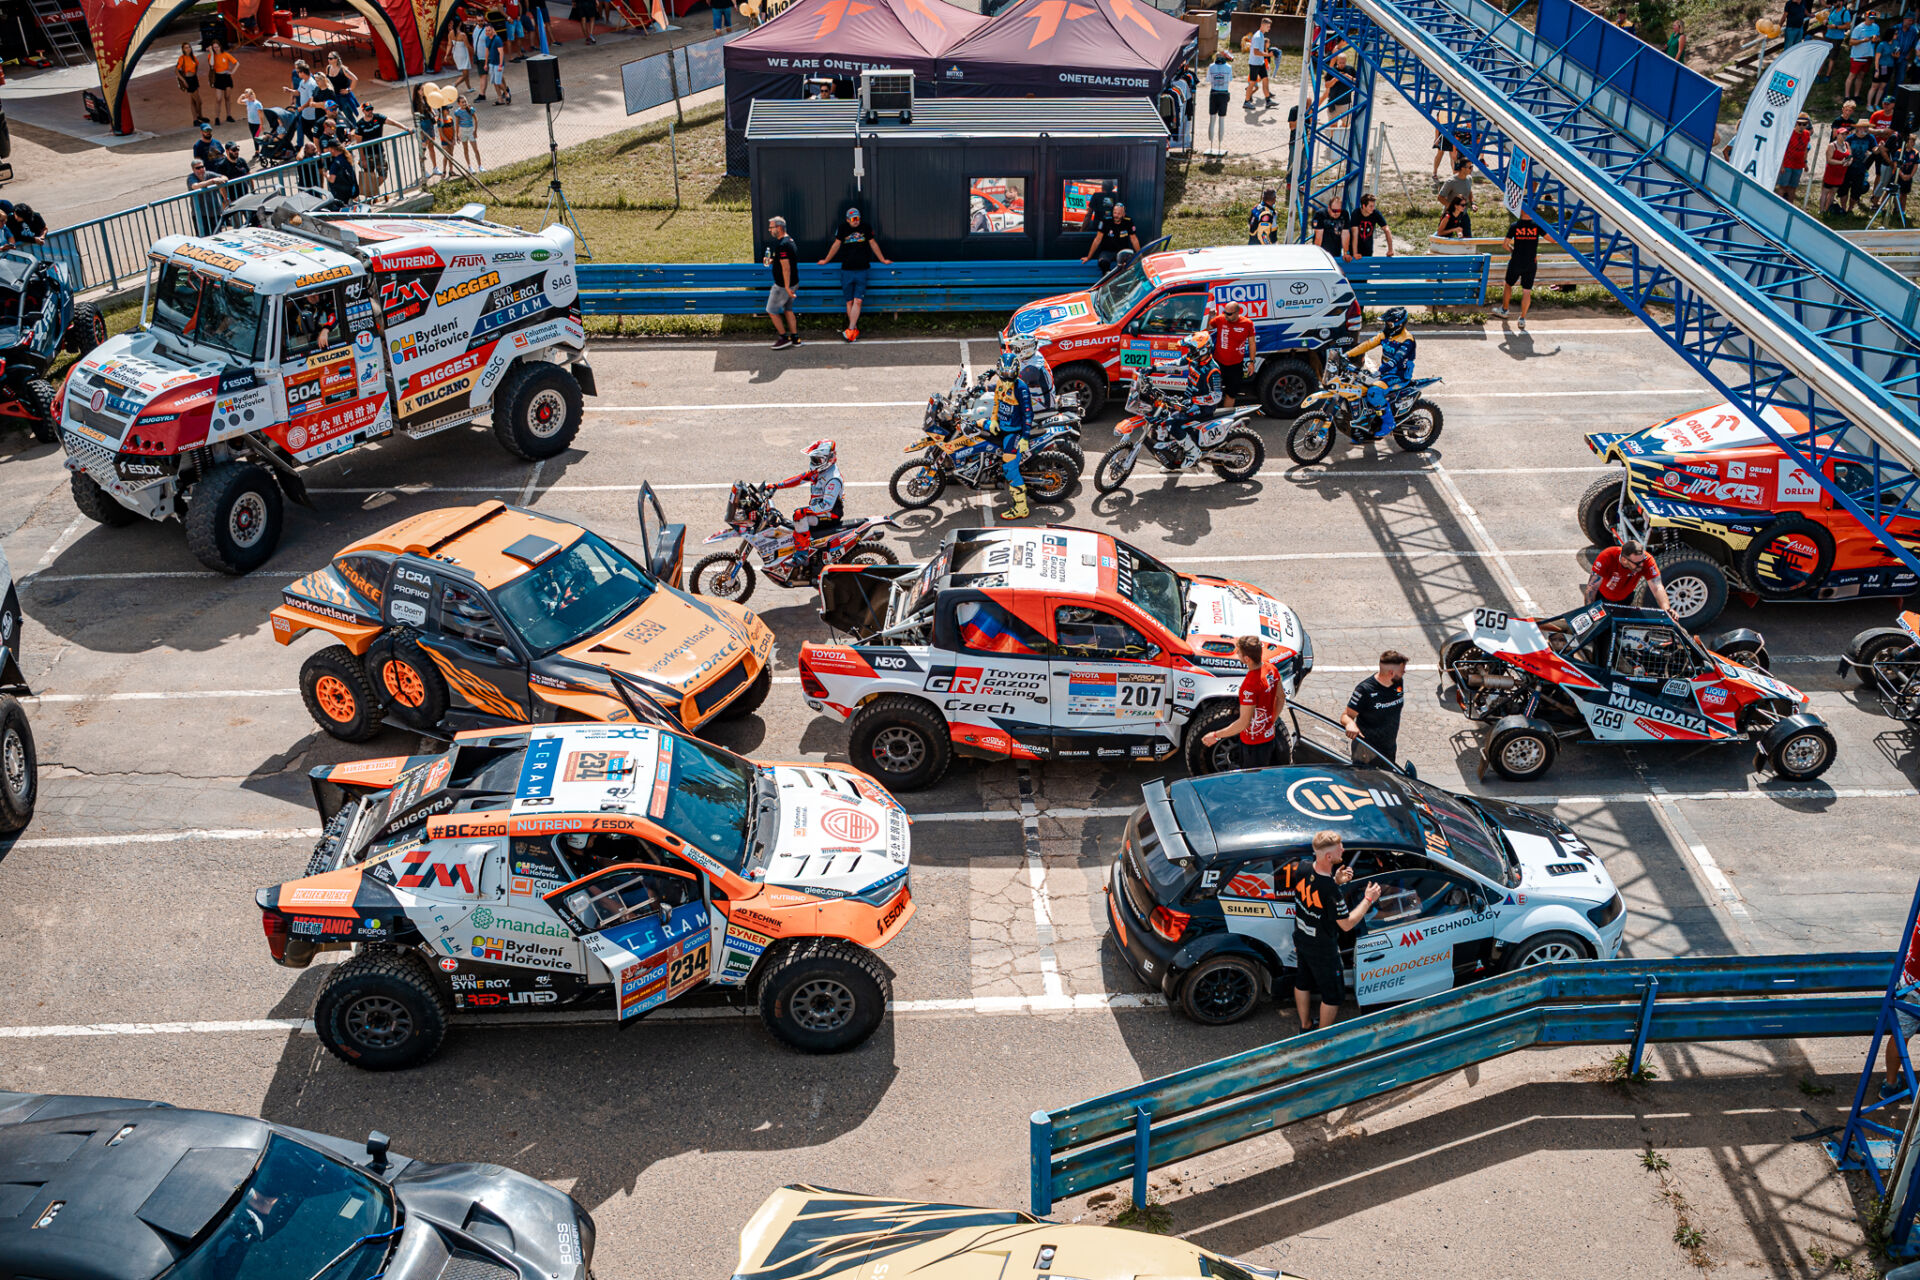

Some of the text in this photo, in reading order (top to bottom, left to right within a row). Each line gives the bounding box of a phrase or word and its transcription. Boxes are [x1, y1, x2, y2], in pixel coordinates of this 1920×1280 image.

[768, 58, 891, 71] WE ARE ONETEAM
[1059, 73, 1150, 88] ONETEAM.STORE
[382, 255, 436, 270] NUTREND
[449, 254, 487, 269] FRUM
[552, 275, 572, 290] SAG
[495, 283, 539, 309] SYNERGY
[1217, 285, 1265, 302] LIQUI
[1285, 298, 1324, 306] BSAUTO
[484, 297, 542, 330] LERAM
[416, 317, 458, 342] Bydlení
[357, 333, 371, 345] 77
[419, 330, 469, 357] Hořovice
[1074, 335, 1120, 347] BSAUTO
[1124, 353, 1147, 365] 2027
[420, 353, 479, 387] BIGGEST
[481, 355, 505, 388] CBSG
[228, 375, 253, 388] ESOX
[174, 390, 213, 406] BIGGEST
[288, 381, 321, 404] 604
[416, 377, 470, 408] VALCANO
[108, 397, 139, 414] LERAM
[141, 415, 175, 424] BUGGYRA
[367, 419, 392, 436] AVEO
[1686, 419, 1714, 444] ORLEN
[306, 435, 353, 459] LERAM
[127, 463, 163, 475] ESOX
[1685, 464, 1719, 476] verva
[1731, 525, 1752, 533] FORD
[1025, 541, 1036, 569] Czech
[1059, 558, 1067, 583] TOYOTA
[1116, 546, 1132, 595] HILUX
[393, 584, 429, 599] PROFIKO
[285, 596, 357, 624] workoutland
[1122, 599, 1166, 632] MUSICDATA
[1213, 601, 1222, 624] TOYOTA
[1284, 611, 1294, 638] Czech
[1474, 608, 1509, 631] 269
[648, 625, 715, 674] workoutland
[812, 650, 847, 660] TOYOTA
[875, 656, 907, 669] NEXO
[1201, 657, 1248, 669] MUSICDAT
[988, 669, 1048, 681] TOYOTA
[926, 677, 978, 693] GR
[983, 678, 1040, 690] GAZOO
[1705, 687, 1728, 697] LIQUI
[981, 686, 1036, 700] Racing
[1121, 686, 1161, 707] 207
[1702, 694, 1726, 705] MOLY
[944, 699, 1015, 714] Czech
[1608, 693, 1706, 732] MUSICDATA
[1592, 708, 1624, 730] 269
[1012, 743, 1049, 753] MUSICDATA
[526, 741, 553, 795] LERAM
[391, 796, 453, 833] BUGGYRA
[517, 819, 583, 831] NUTREND
[601, 820, 635, 829] ESOX
[686, 852, 709, 868] KOLOC
[689, 848, 722, 871] DELAUNAY
[770, 893, 806, 902] NUTREND
[804, 886, 844, 898] gleec.com
[883, 898, 905, 929] ESOX
[1227, 905, 1266, 914] SILMET
[496, 917, 570, 938] mandala
[749, 910, 783, 928] TECHNIK
[1423, 911, 1501, 937] TECHNOLOGY
[358, 927, 387, 936] EKOPOS
[626, 912, 709, 950] LERAM
[728, 926, 767, 945] SYNER
[506, 940, 563, 957] Bydlení
[684, 932, 709, 949] aramco
[725, 937, 762, 953] pumpa
[504, 952, 573, 970] Hořovice
[670, 946, 708, 987] 234
[1360, 949, 1451, 982] VÝCHODOČESKÁ
[452, 979, 511, 990] SYNERGY
[625, 967, 664, 992] aramco
[1357, 975, 1406, 996] ENERGIE
[468, 991, 558, 1006] RED-LINED
[557, 1222, 572, 1265] BOSS
